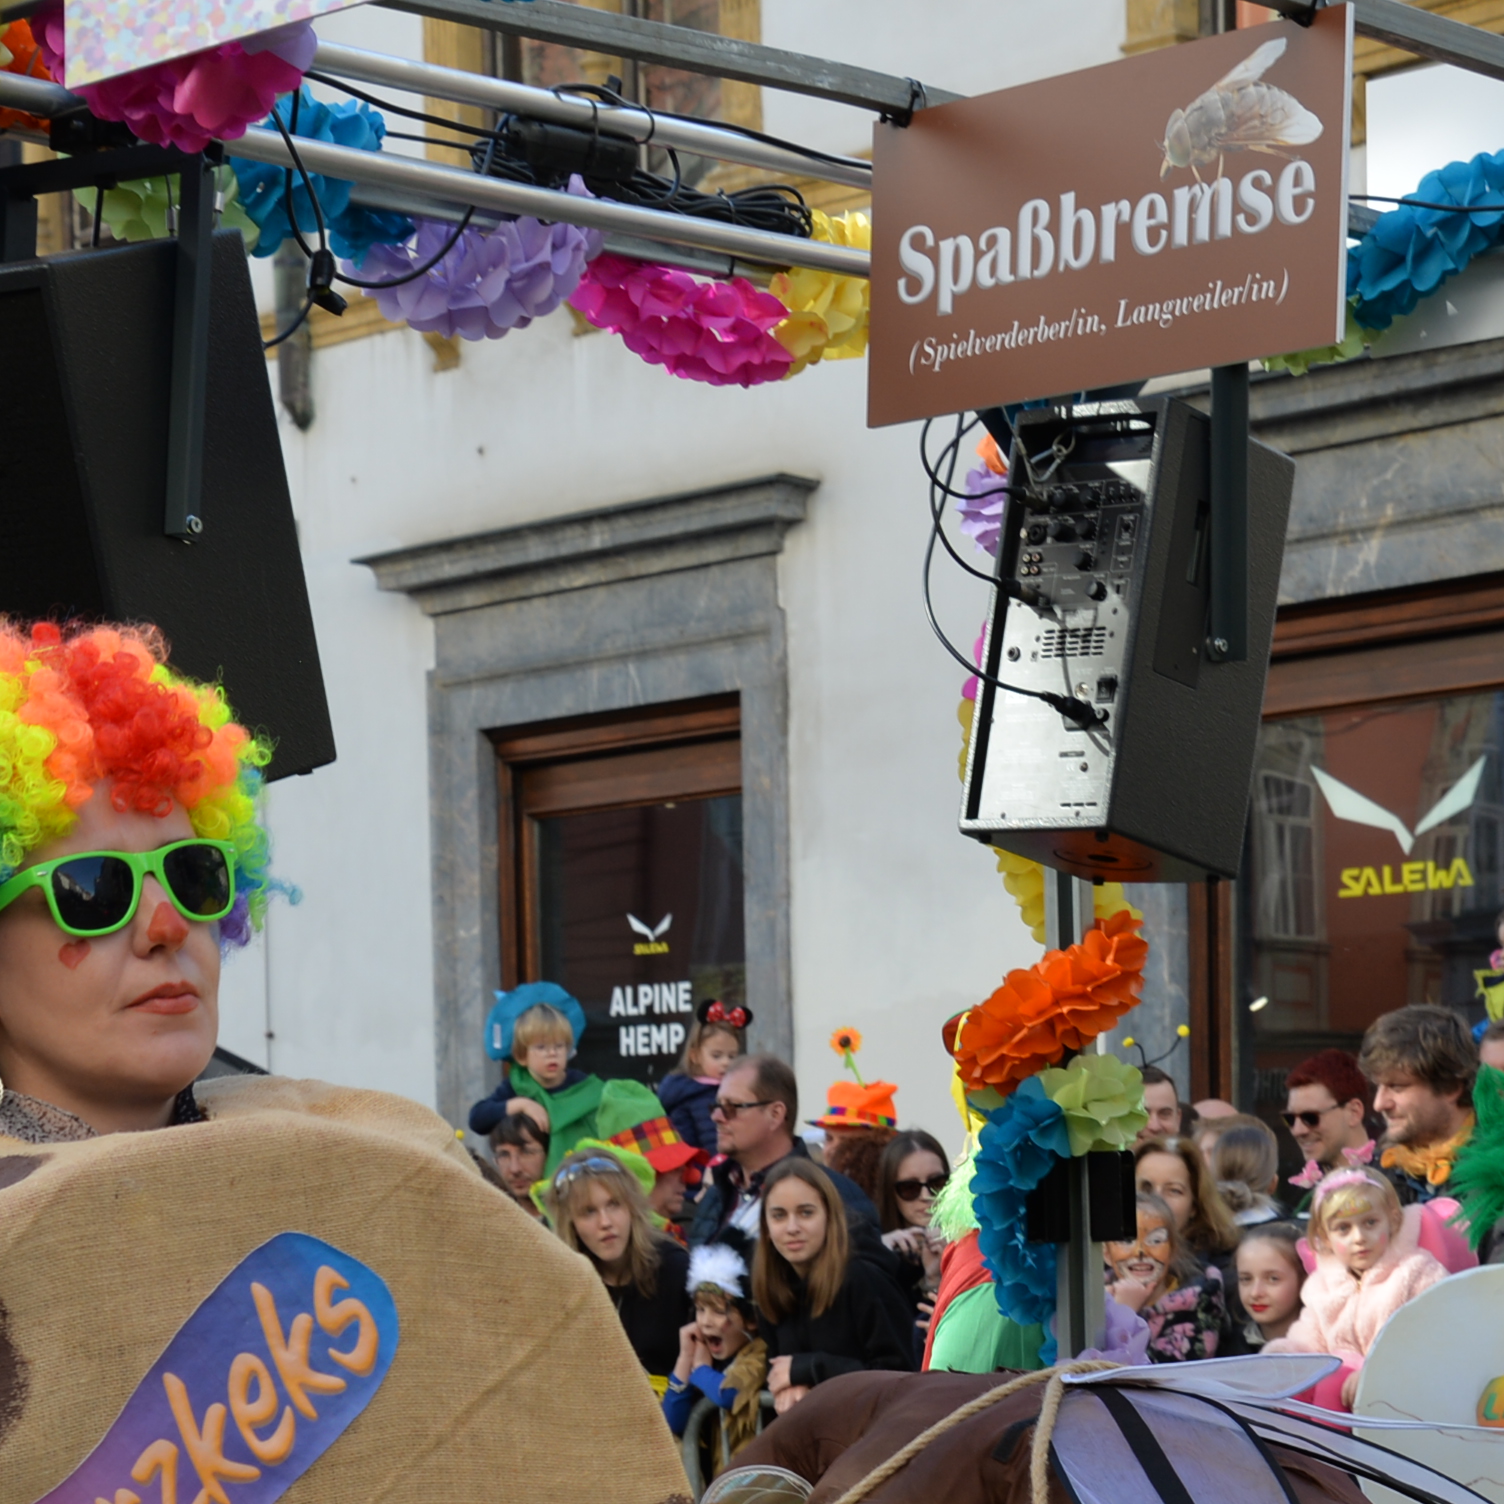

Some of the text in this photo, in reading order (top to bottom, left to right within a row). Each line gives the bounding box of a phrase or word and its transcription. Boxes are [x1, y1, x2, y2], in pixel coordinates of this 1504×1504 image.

[897, 159, 1316, 316] Spaßbremse
[908, 267, 1289, 375] (Spielverderber/in, Langweiler/in)
[1338, 857, 1474, 898] SALEWA
[609, 980, 693, 1017] ALPINE
[619, 1022, 686, 1057] HEMP
